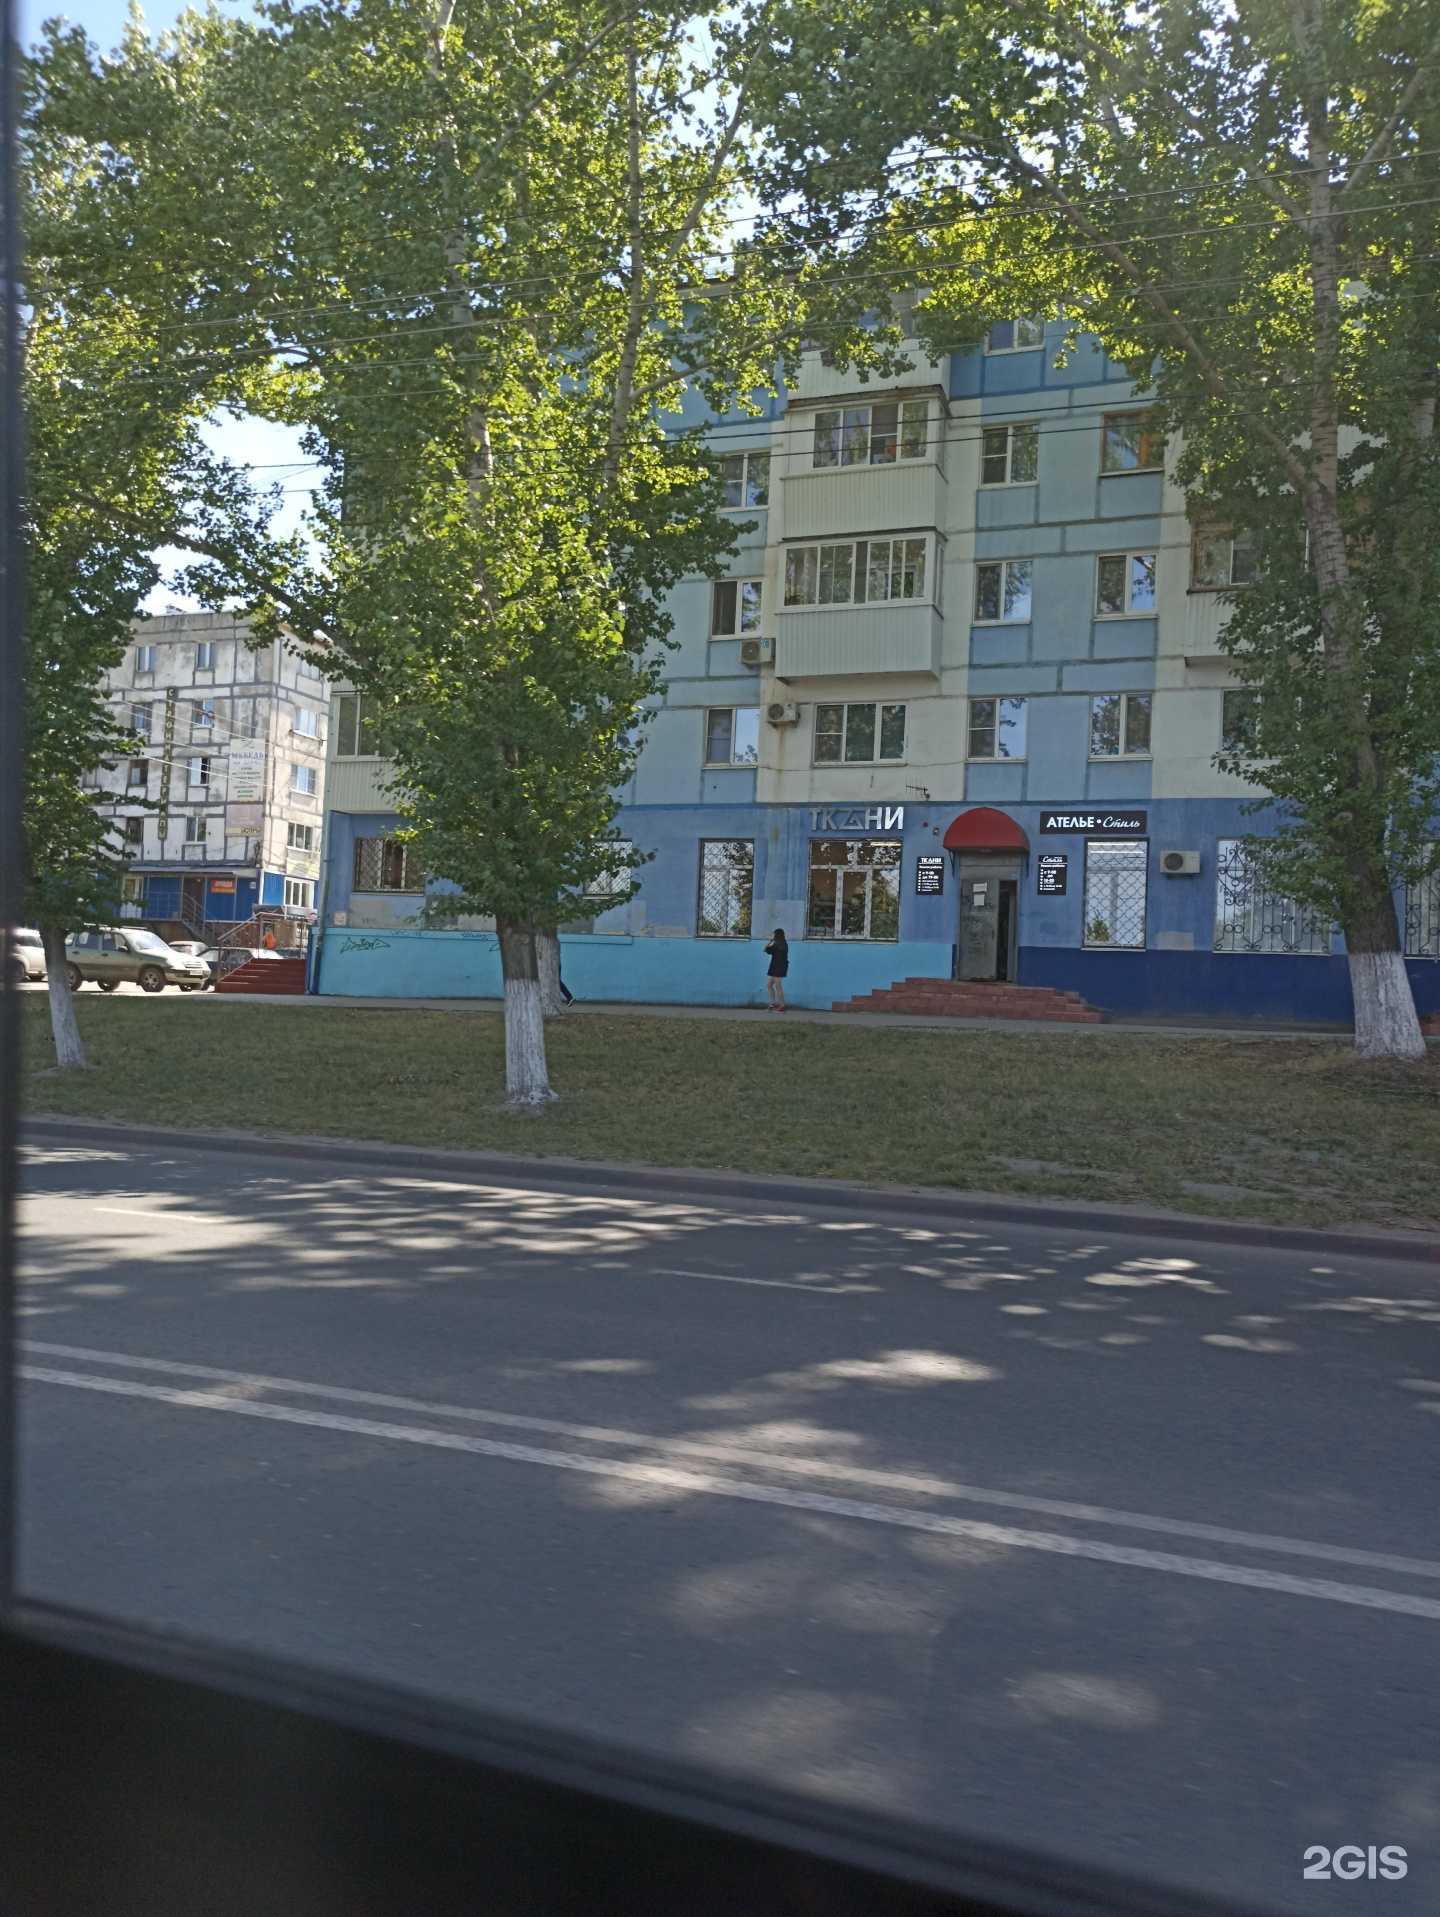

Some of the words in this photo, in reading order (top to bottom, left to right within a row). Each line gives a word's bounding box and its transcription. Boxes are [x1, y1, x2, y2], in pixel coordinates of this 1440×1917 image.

[808, 806, 905, 831] ТКАНИ
[1046, 816, 1095, 828] АТЕЛЬЕ
[1103, 816, 1141, 828] Стиль
